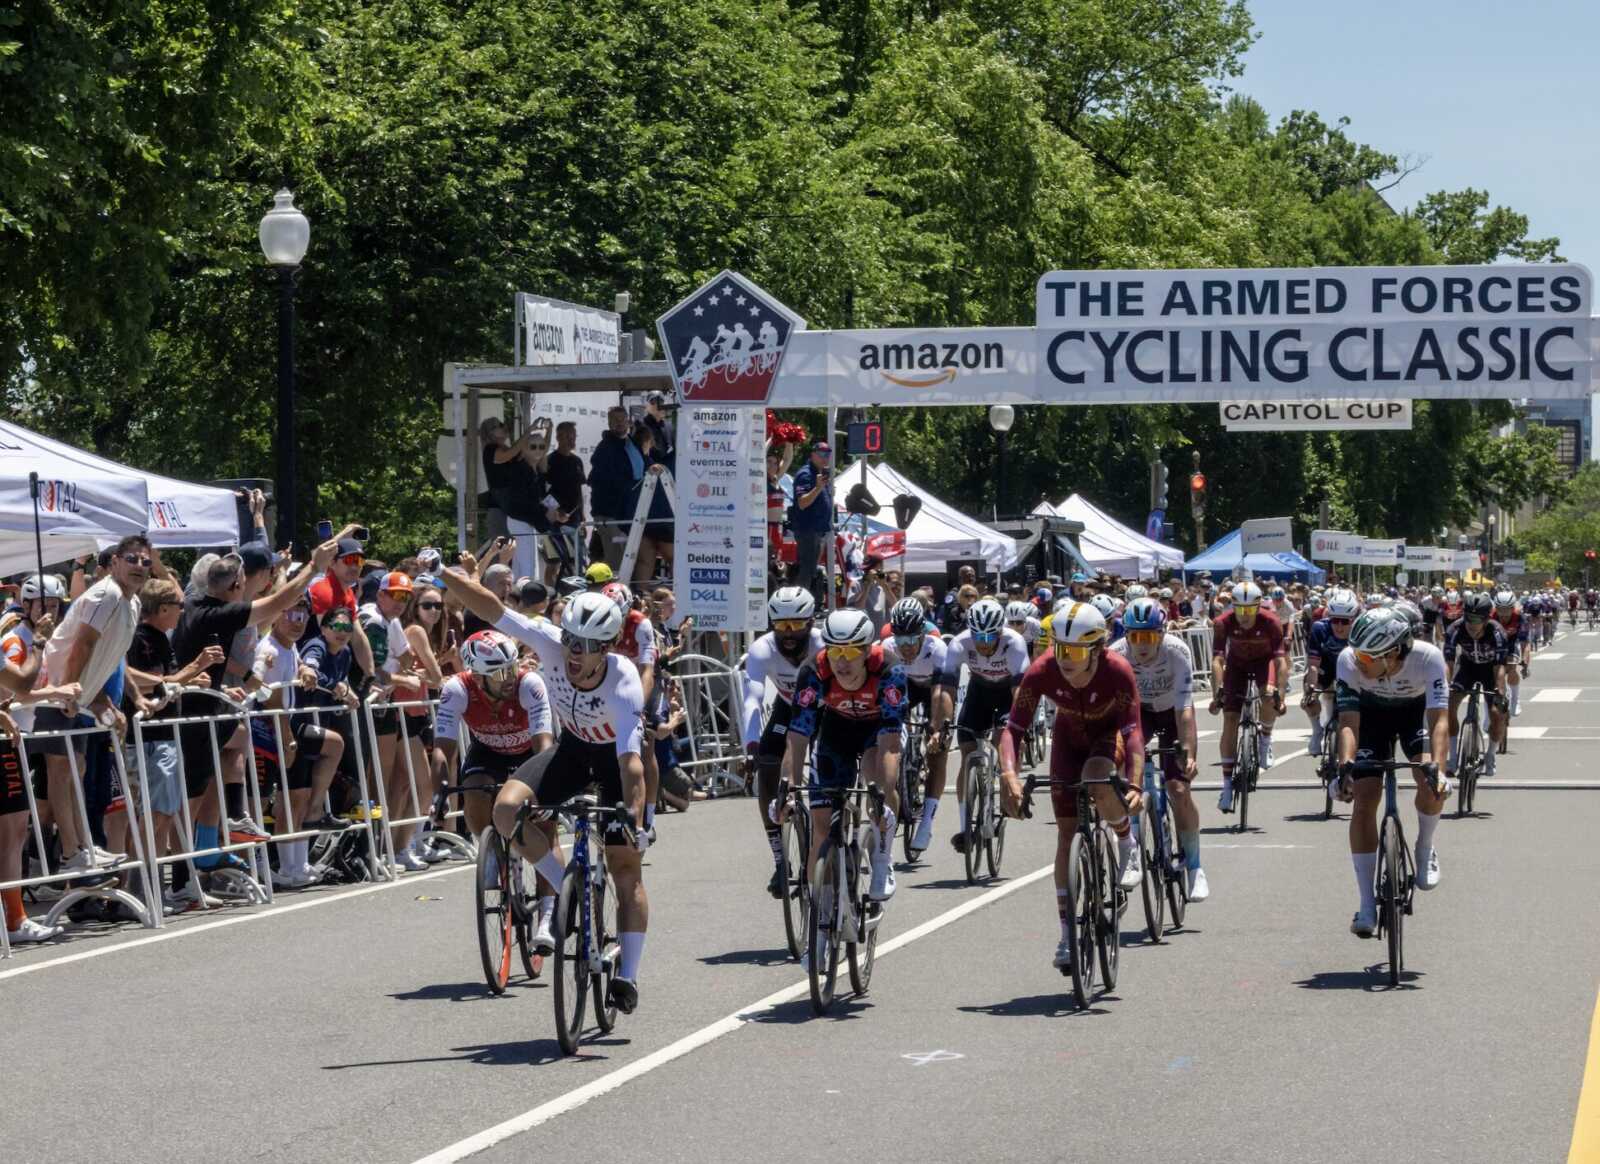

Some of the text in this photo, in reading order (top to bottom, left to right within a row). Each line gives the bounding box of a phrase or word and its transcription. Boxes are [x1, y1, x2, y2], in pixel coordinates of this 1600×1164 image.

[1045, 275, 1582, 317] THE ARMED FORCES
[533, 321, 565, 354] amazon
[859, 341, 1004, 370] amazon
[1046, 325, 1575, 385] CYCLING CLASSIC
[693, 411, 737, 421] amazon
[1223, 402, 1403, 421] CAPITOL CUP
[692, 440, 736, 453] TOTAL
[865, 424, 882, 452] 0
[37, 479, 81, 514] TOTAL
[711, 486, 728, 497] JLL
[149, 501, 187, 528] TOTAL
[691, 569, 729, 580] CLARK
[690, 588, 729, 602] DELL
[1, 752, 22, 798] TOTAL
